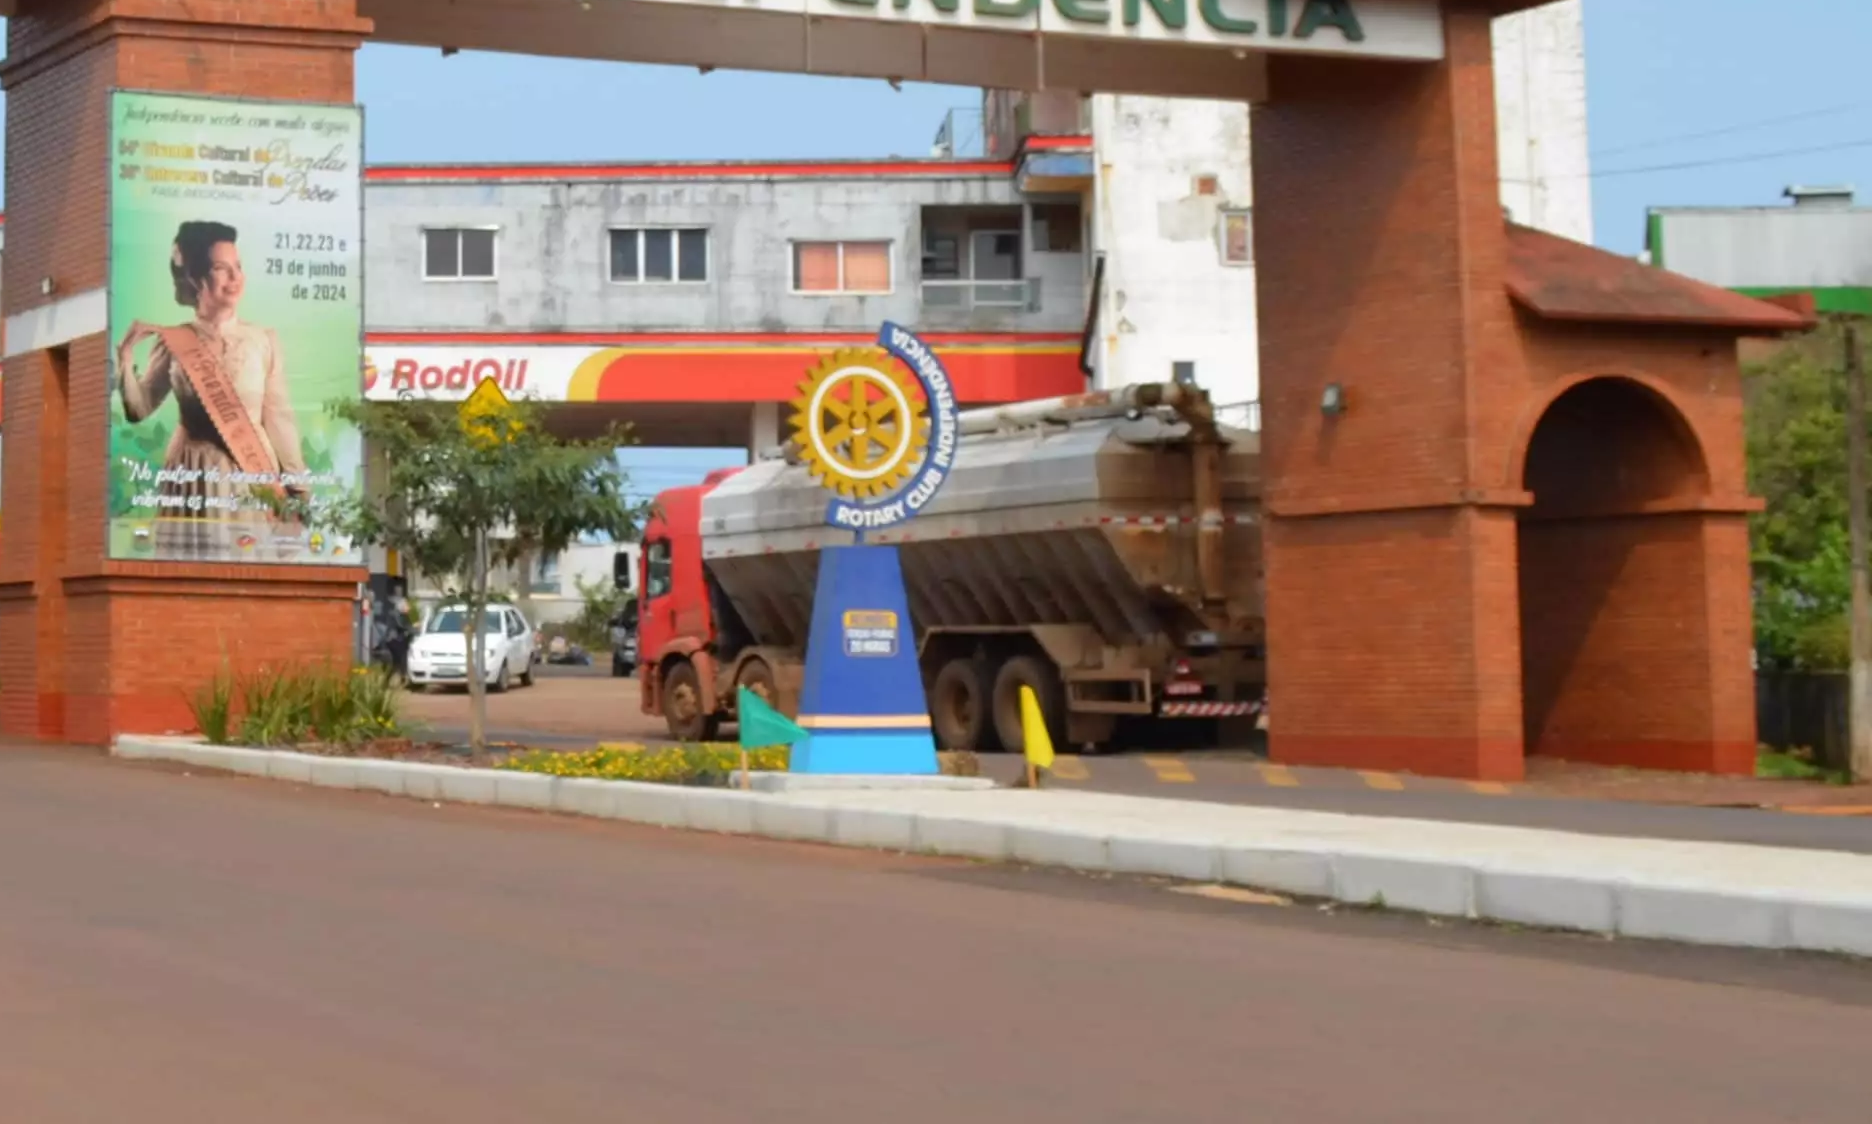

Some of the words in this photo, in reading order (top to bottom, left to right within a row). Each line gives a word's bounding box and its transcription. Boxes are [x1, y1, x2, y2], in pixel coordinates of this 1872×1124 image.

[338, 239, 347, 252] e
[265, 257, 283, 275] 29
[287, 259, 305, 276] de
[308, 259, 347, 280] junho
[291, 282, 309, 300] de
[312, 283, 347, 301] 2024
[835, 499, 907, 527] ROTARY
[905, 467, 944, 510] CLUB
